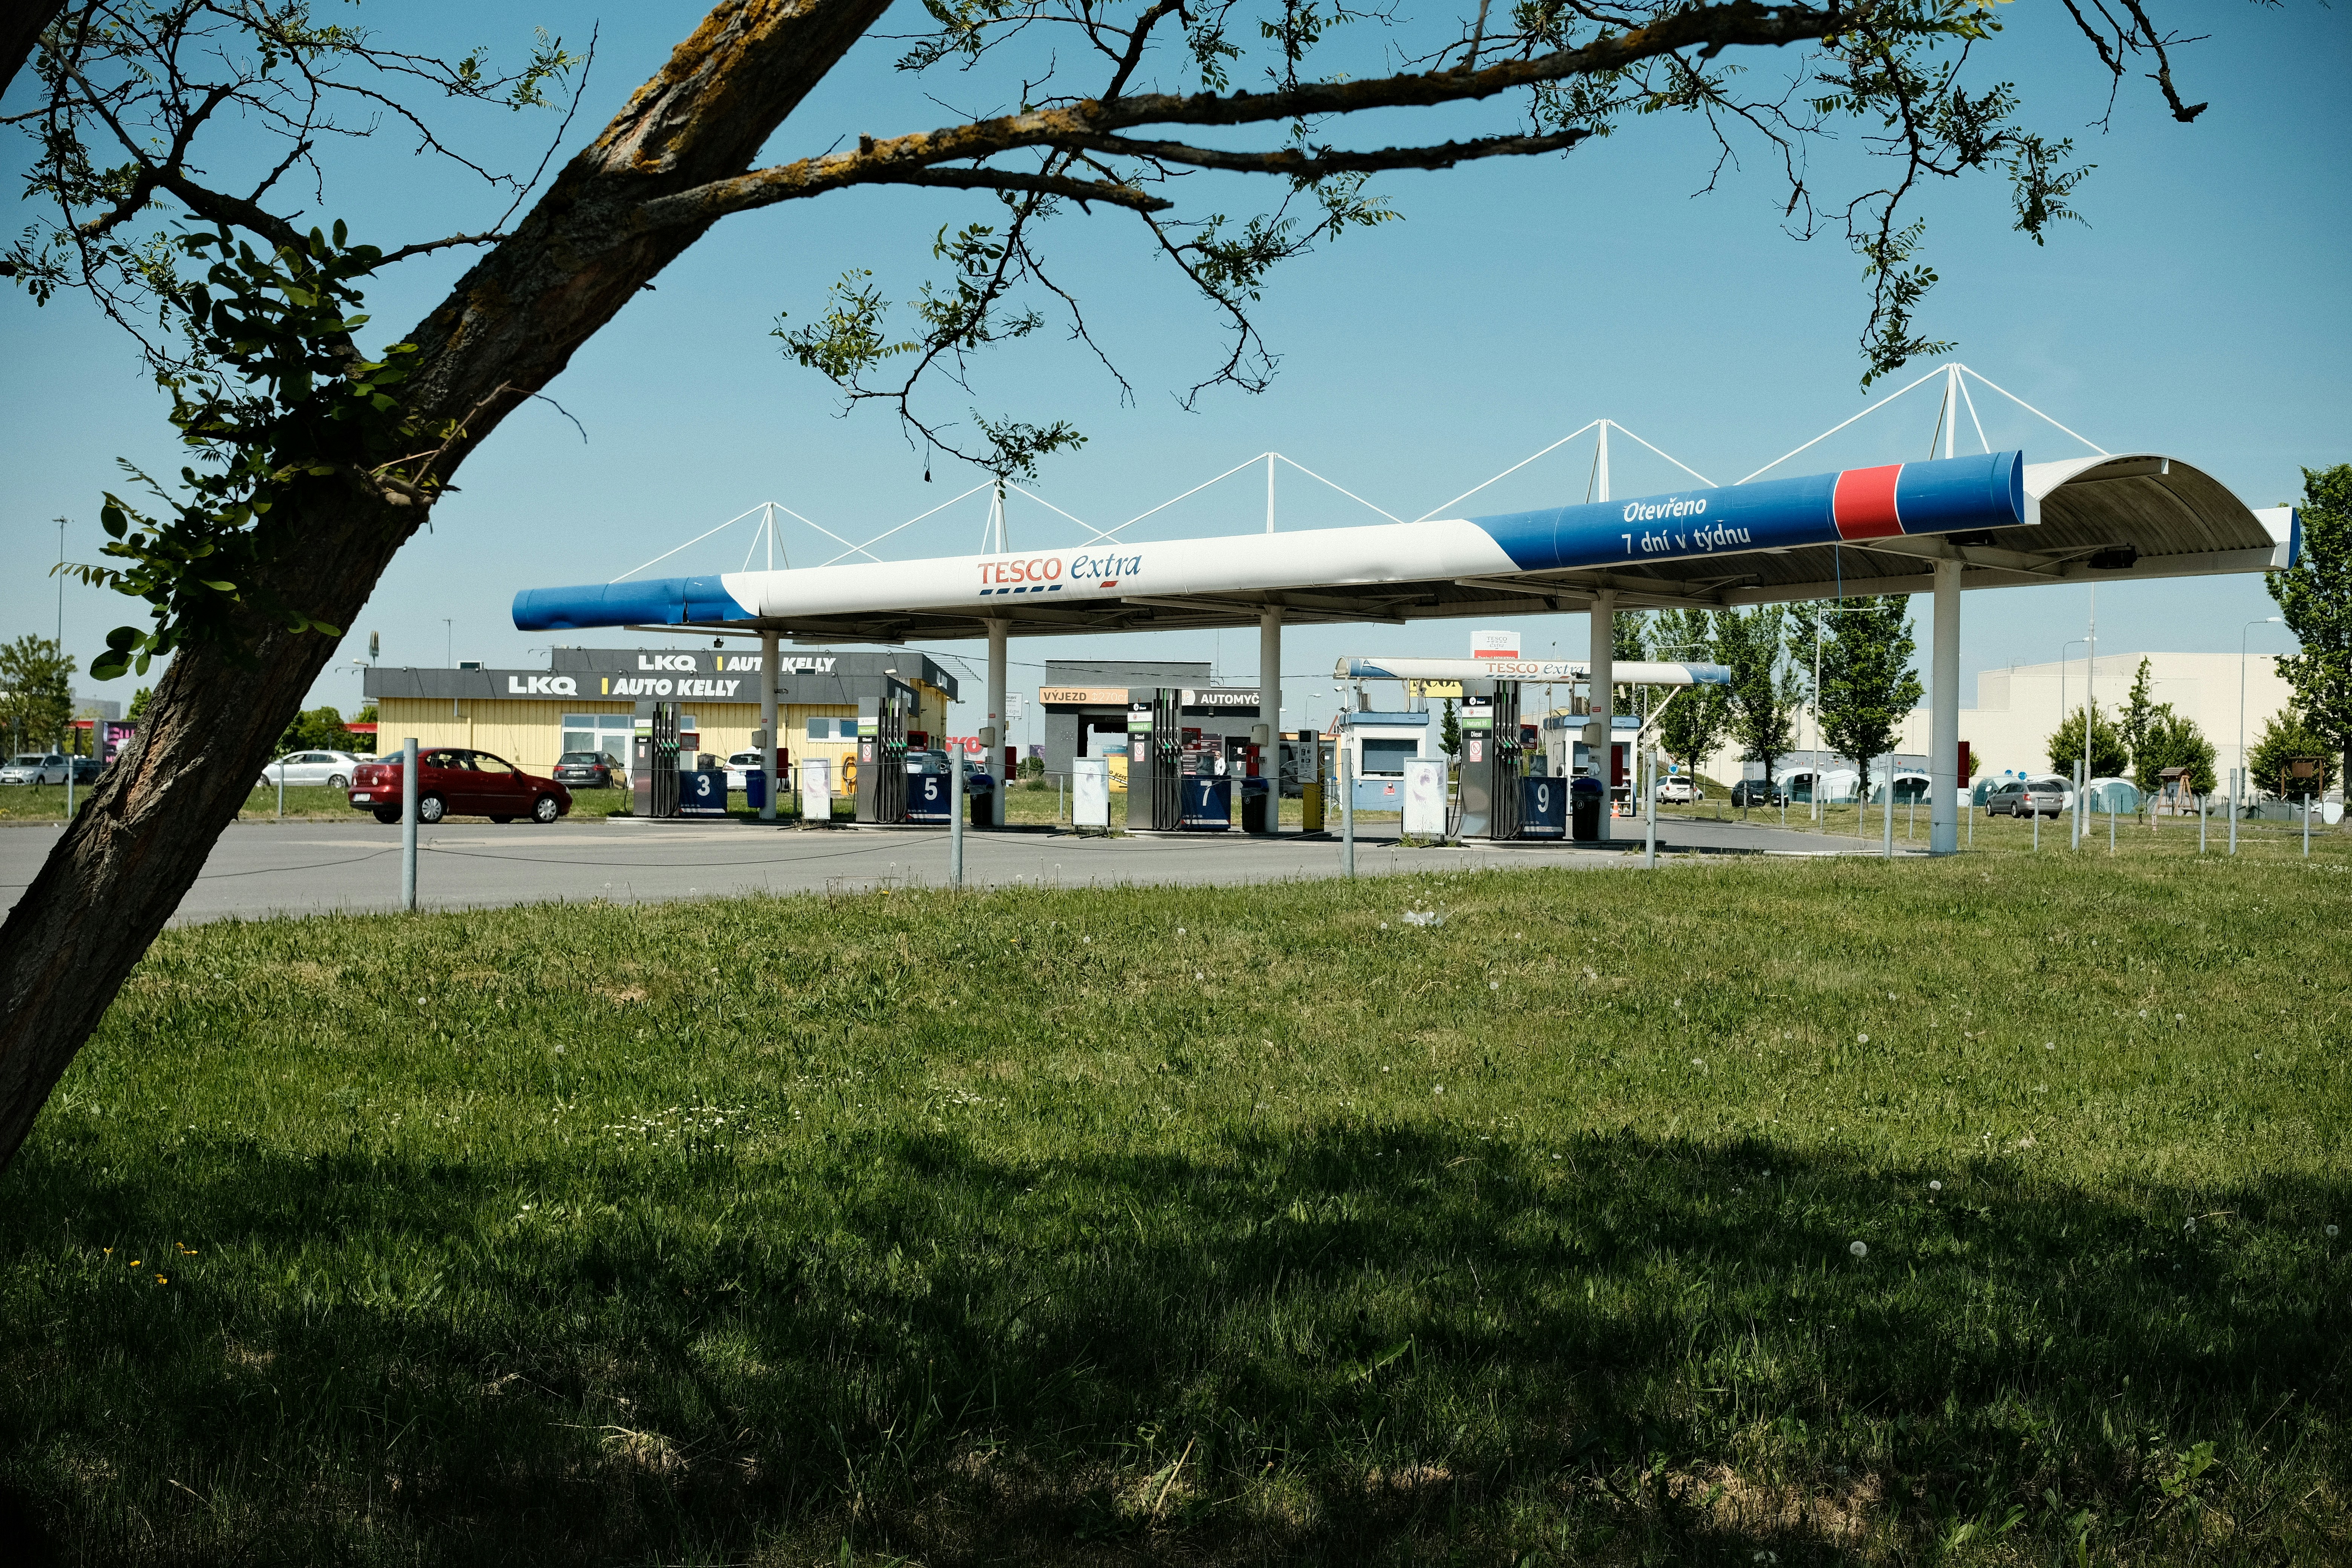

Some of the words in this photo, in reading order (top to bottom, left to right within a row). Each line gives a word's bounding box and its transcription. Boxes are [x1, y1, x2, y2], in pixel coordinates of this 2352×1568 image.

[1624, 498, 1706, 522] Otevřeno
[1622, 534, 1631, 554] 7
[1641, 530, 1670, 553] dní
[1675, 534, 1686, 549] v
[1694, 524, 1751, 551] týdnu
[978, 557, 1062, 584] TESCO
[1071, 553, 1142, 579] extra
[639, 655, 697, 672] LKQ
[726, 657, 763, 671] AUT
[782, 657, 836, 672] KELLY
[1485, 663, 1538, 674] TESCO
[1544, 663, 1584, 674] extra
[509, 676, 578, 695] LKQ
[612, 678, 672, 695] AUTO
[677, 679, 740, 697] KELLY
[1043, 690, 1087, 701] VÝJEZD
[1200, 693, 1260, 704] AUTOMYČ
[697, 775, 710, 796] 3
[924, 778, 937, 800] 5
[1200, 781, 1212, 806] 7
[1538, 784, 1549, 813] 9
